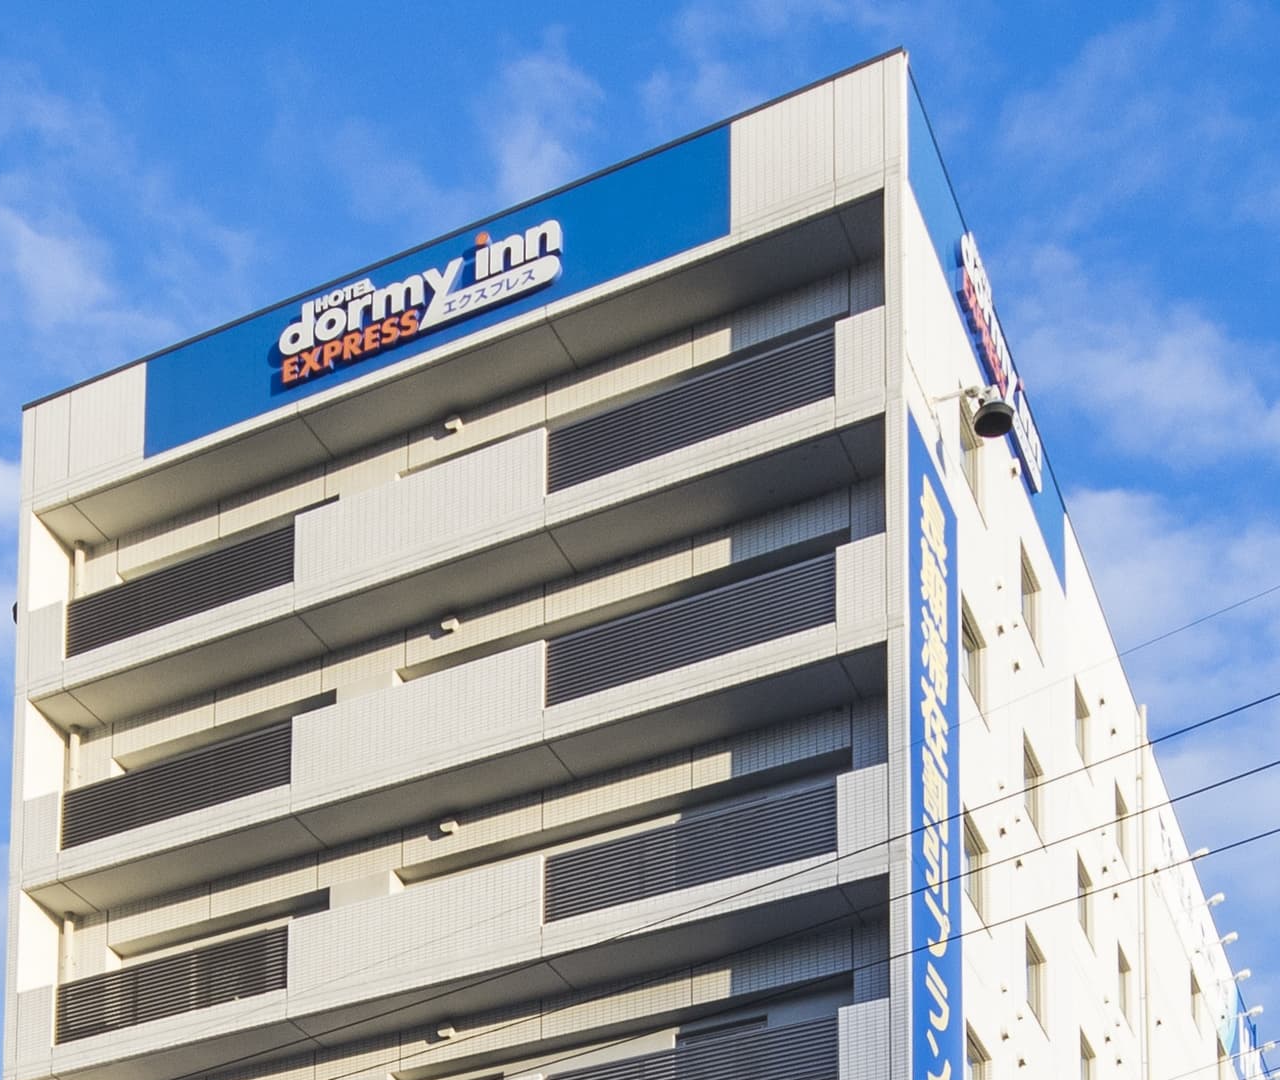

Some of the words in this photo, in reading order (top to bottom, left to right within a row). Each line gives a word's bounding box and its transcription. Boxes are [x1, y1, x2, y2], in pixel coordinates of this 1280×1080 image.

[278, 256, 463, 355] dormy
[474, 219, 563, 280] inn
[315, 277, 375, 313] HOTEL
[444, 268, 536, 315] エクスプレス
[281, 309, 420, 384] EXPRESS
